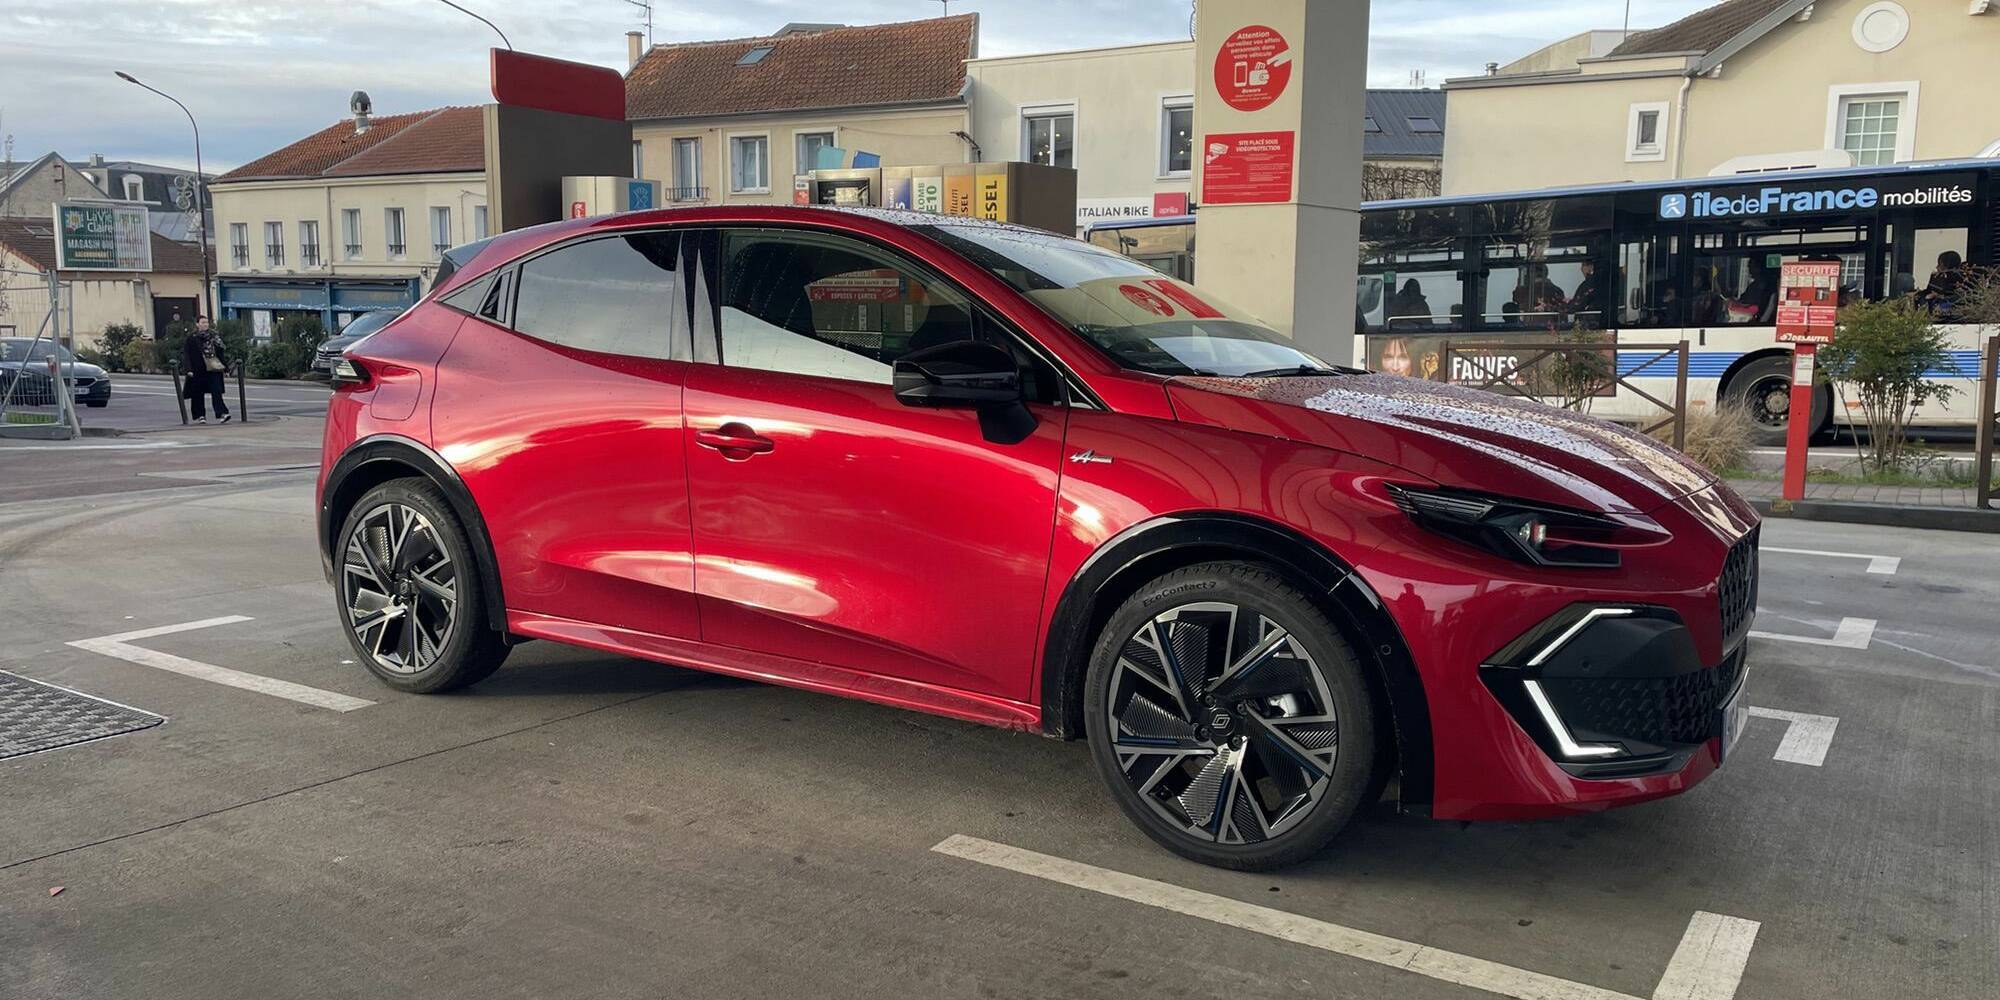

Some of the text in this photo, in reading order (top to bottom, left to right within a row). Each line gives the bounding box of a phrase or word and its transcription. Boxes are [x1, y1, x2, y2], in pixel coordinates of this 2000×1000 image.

[1236, 31, 1270, 39] Attention
[917, 182, 925, 210] LOMB
[960, 193, 969, 215] SEL
[985, 180, 998, 220] ESEL
[1883, 185, 1972, 207] mobilités
[1078, 206, 1149, 217] ITALIAN BIKE
